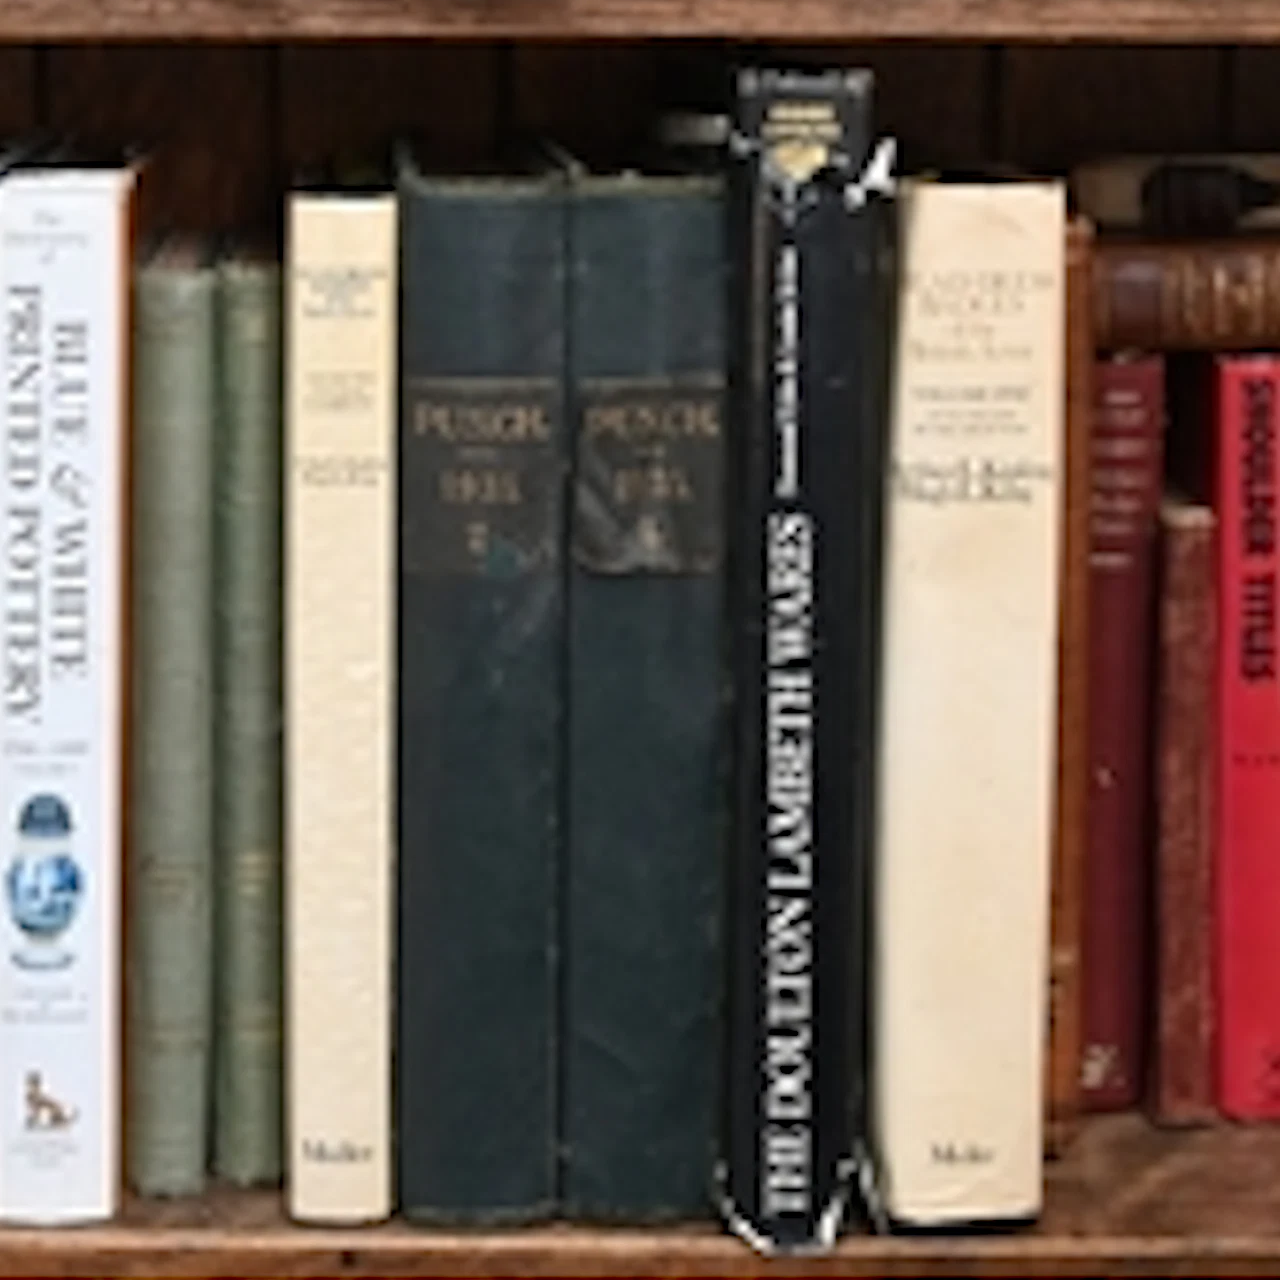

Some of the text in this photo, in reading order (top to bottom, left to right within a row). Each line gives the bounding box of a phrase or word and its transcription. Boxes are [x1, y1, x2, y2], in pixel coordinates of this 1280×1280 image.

[5, 285, 43, 726] PRINTED POTTERY
[50, 320, 90, 681] BLUE & WHITE
[1240, 378, 1277, 682] SHOULDER TITLES
[762, 512, 814, 1215] THE DOULTON LAMBETH WARES
